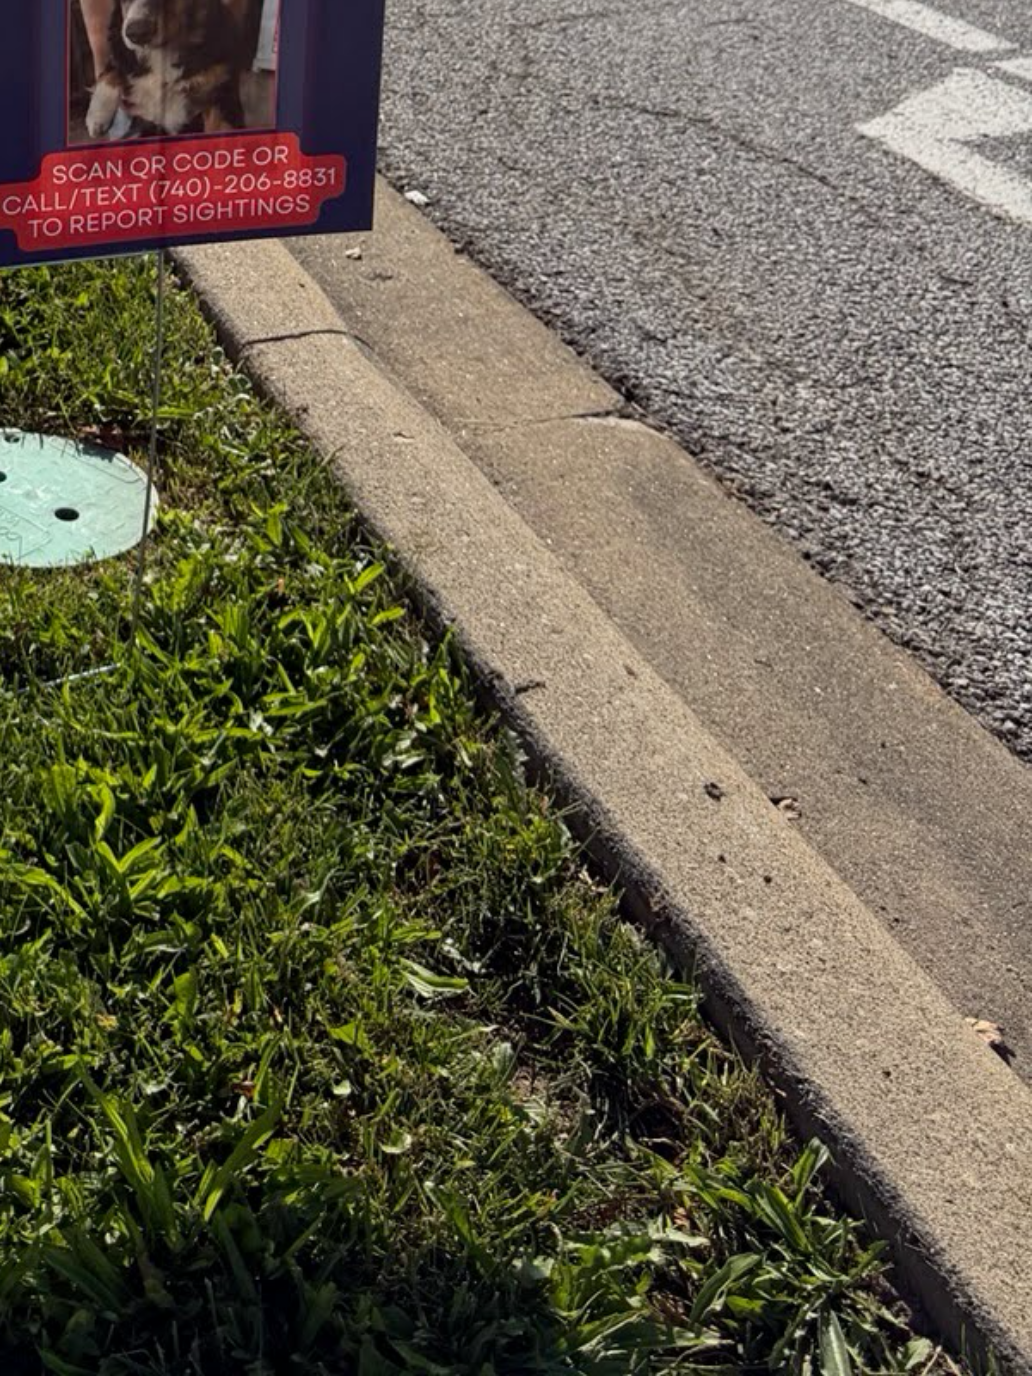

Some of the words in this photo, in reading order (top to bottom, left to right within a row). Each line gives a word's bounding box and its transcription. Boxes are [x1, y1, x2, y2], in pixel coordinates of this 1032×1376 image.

[52, 159, 123, 184] SCAN
[130, 155, 166, 180] QR
[173, 149, 245, 173] CODE
[253, 145, 288, 167] OR
[2, 183, 143, 216] CALL/TEXT
[148, 167, 335, 203] (740)-206-8831
[28, 217, 62, 238] TO
[70, 207, 167, 234] REPORT
[173, 194, 310, 223] SIGHTINGS
